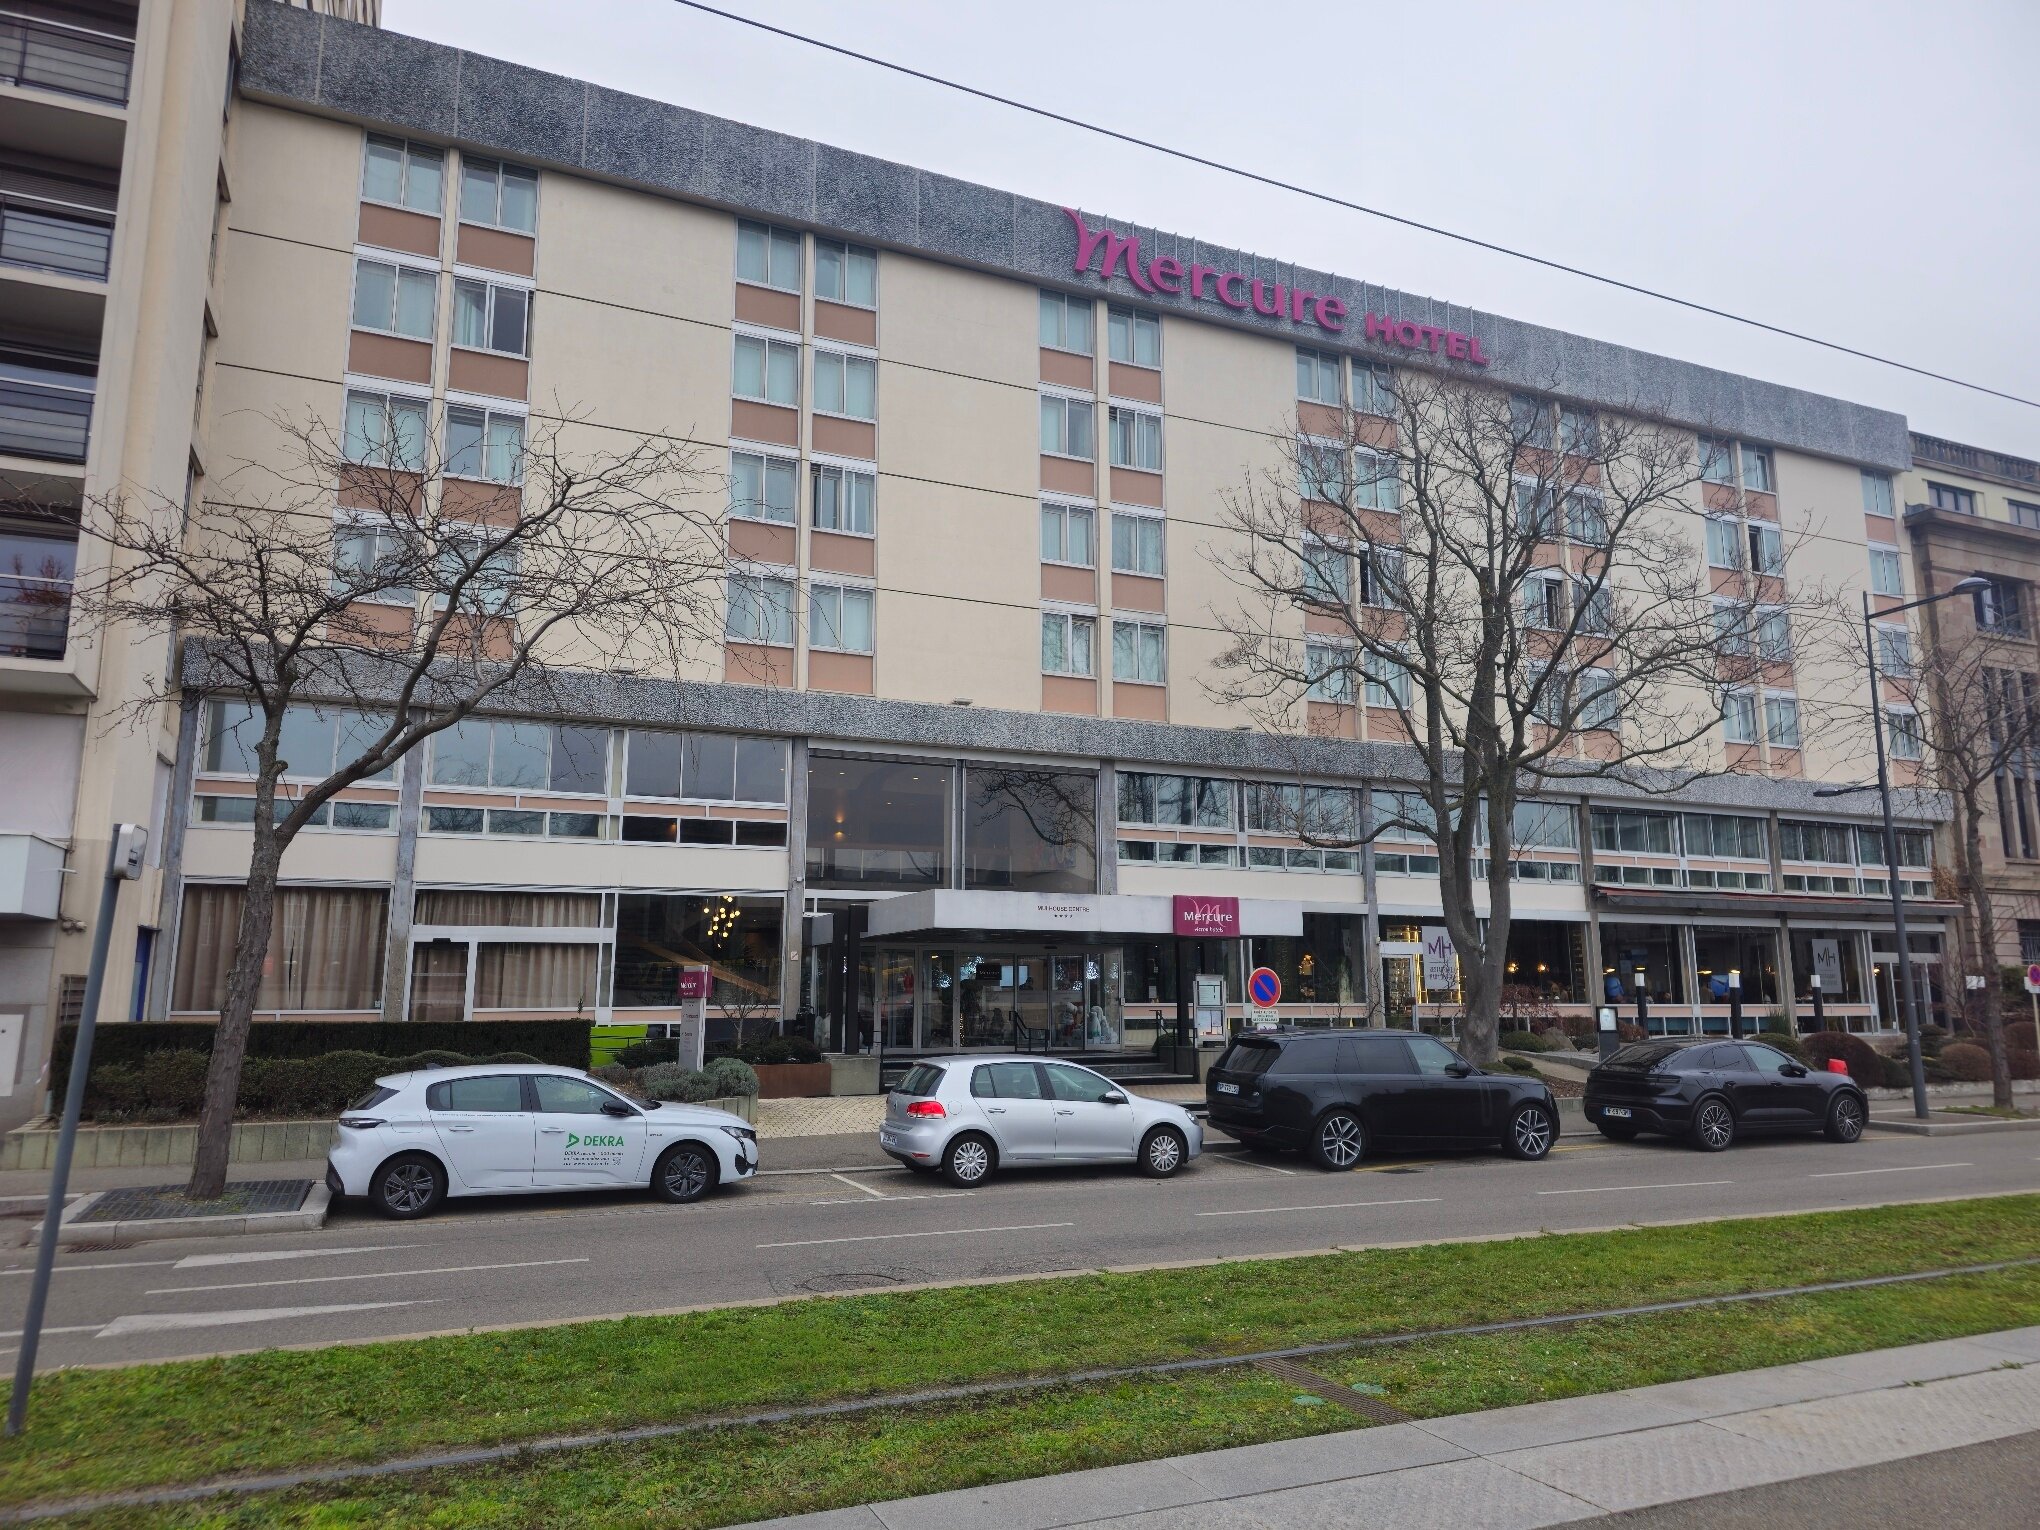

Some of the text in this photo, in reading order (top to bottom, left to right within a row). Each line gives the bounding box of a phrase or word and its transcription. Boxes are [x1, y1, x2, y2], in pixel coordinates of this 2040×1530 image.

[1062, 206, 1490, 366] Mercure HOTEL
[1184, 911, 1233, 922] Mercure
[583, 1135, 625, 1147] DEKRA
